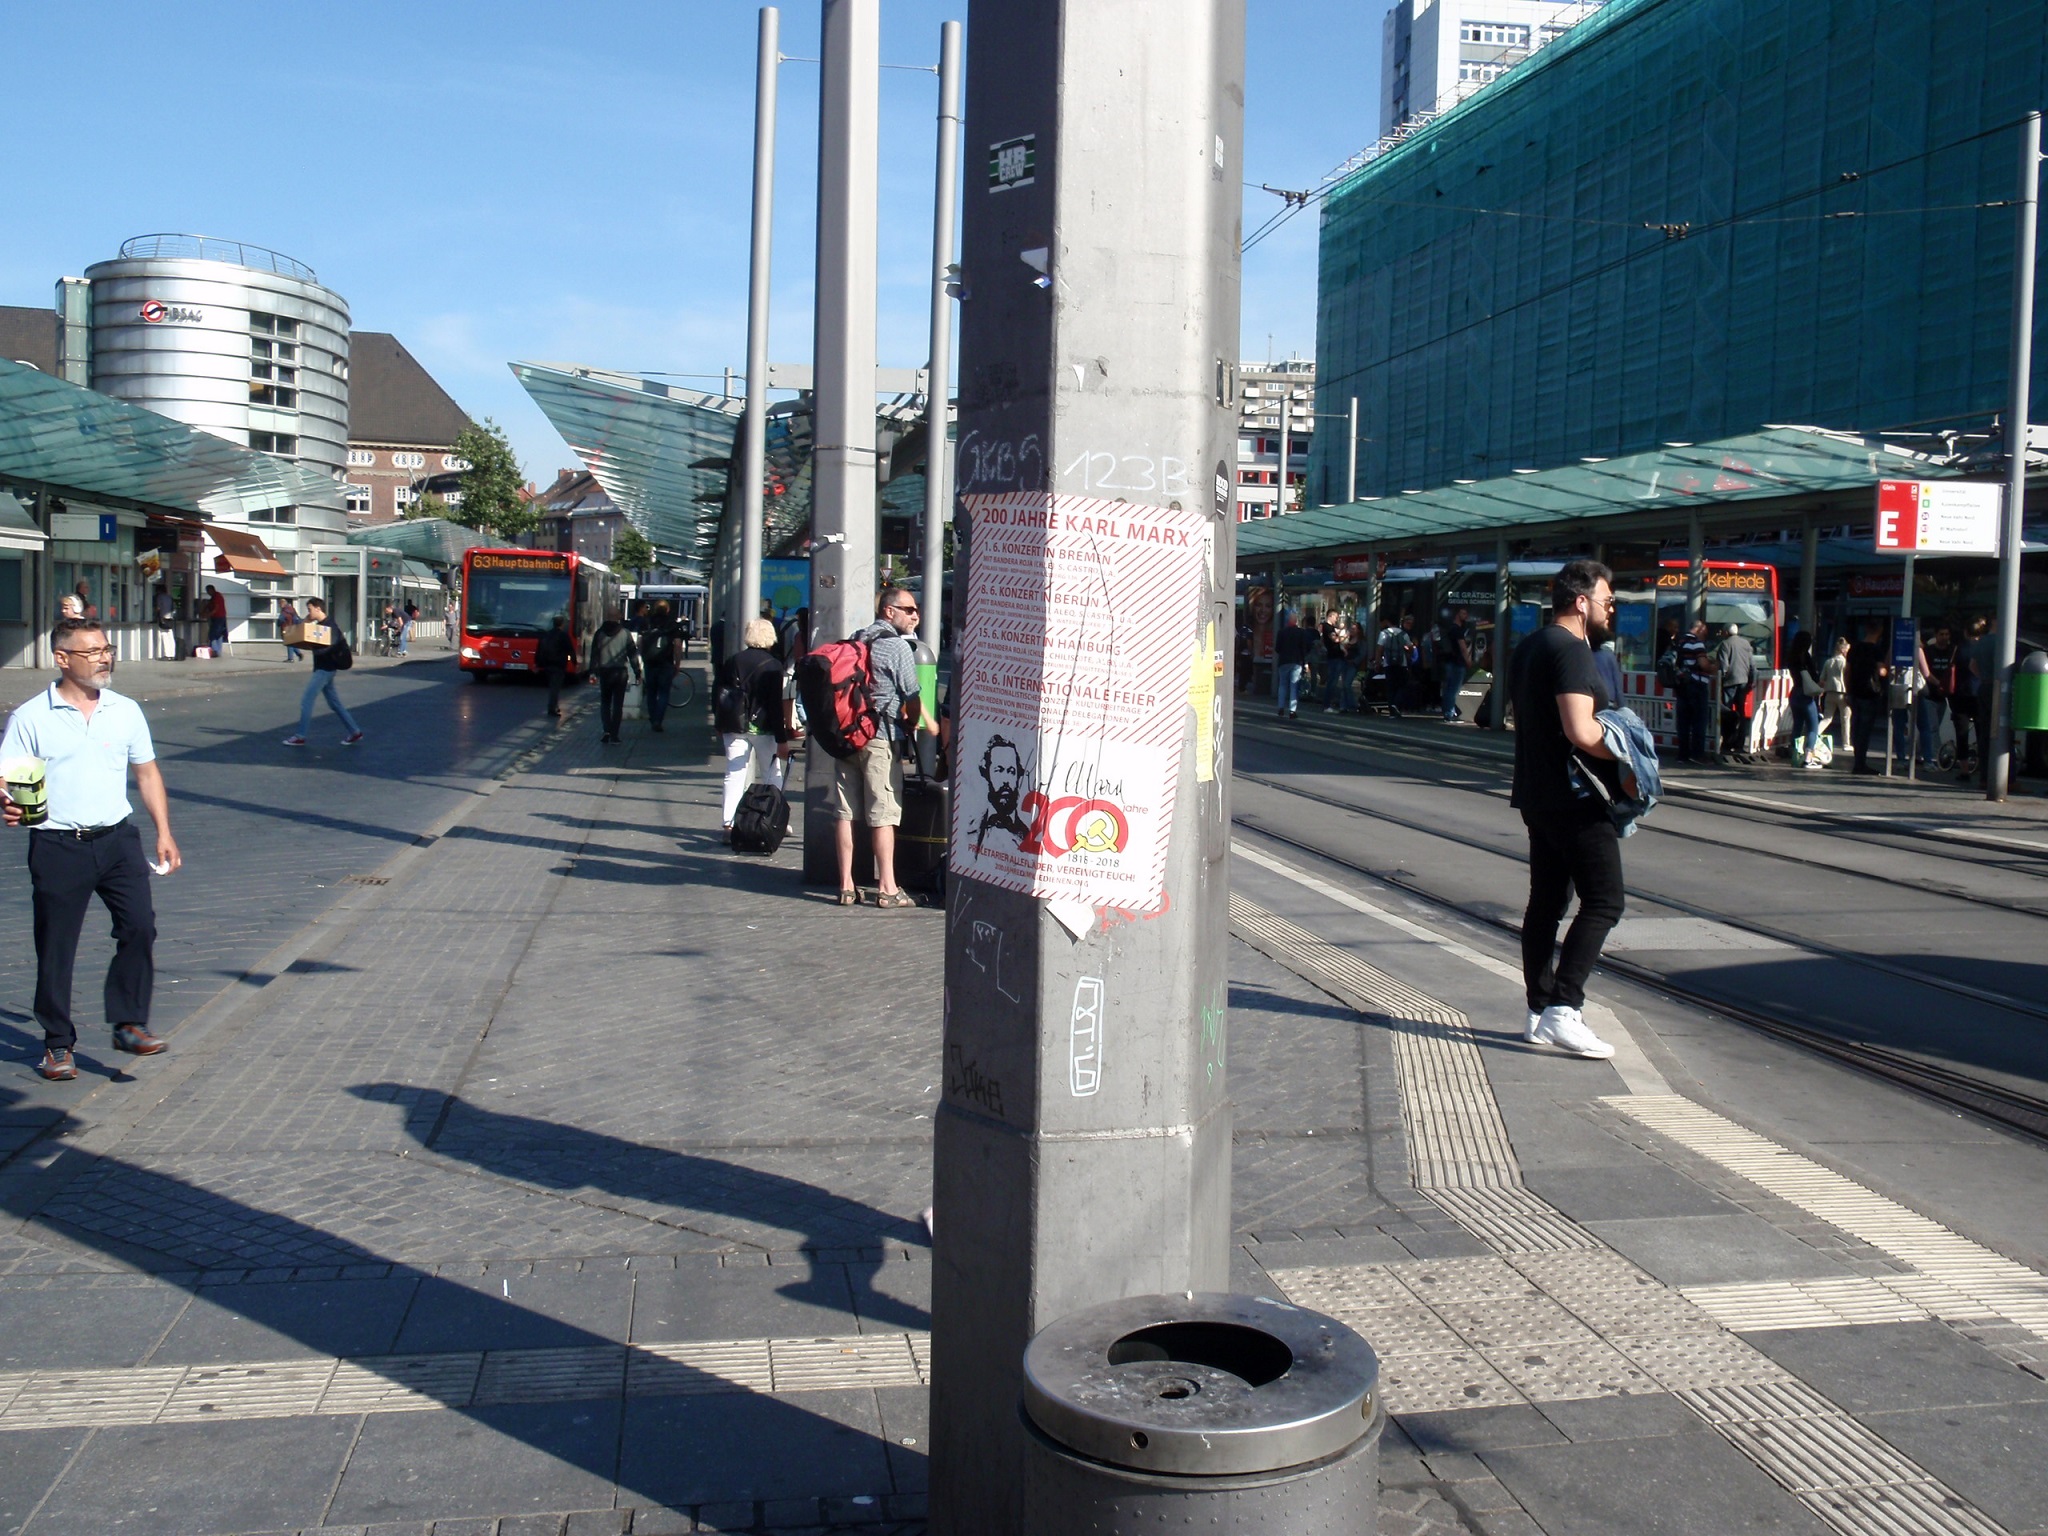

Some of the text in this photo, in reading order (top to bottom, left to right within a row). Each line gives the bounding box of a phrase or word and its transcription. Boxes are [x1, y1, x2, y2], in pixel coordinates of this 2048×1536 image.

[1063, 450, 1190, 496] 123B
[982, 508, 1190, 548] 200 JAHRE KARL MARX
[1879, 511, 1900, 546] E
[473, 555, 566, 570] 63 Hauptbahnhof
[984, 542, 1112, 566] 1. 6. KONZERT IN BREMEN
[980, 584, 1100, 608] 8. 6. KONZERT IN BERLIN
[1462, 590, 1496, 598] GRÄTSCH
[979, 627, 990, 638] 15.
[992, 630, 999, 640] 6.
[1001, 630, 1041, 646] KONZERT
[1042, 637, 1054, 648] IN
[976, 670, 1156, 707] 30. 6. INTERNATIONALE FEIER
[1004, 700, 1016, 708] VON
[1122, 804, 1148, 814] jahre
[1016, 791, 1129, 859] 200
[1096, 856, 1120, 868] 2018
[1106, 870, 1136, 882] EUCH!
